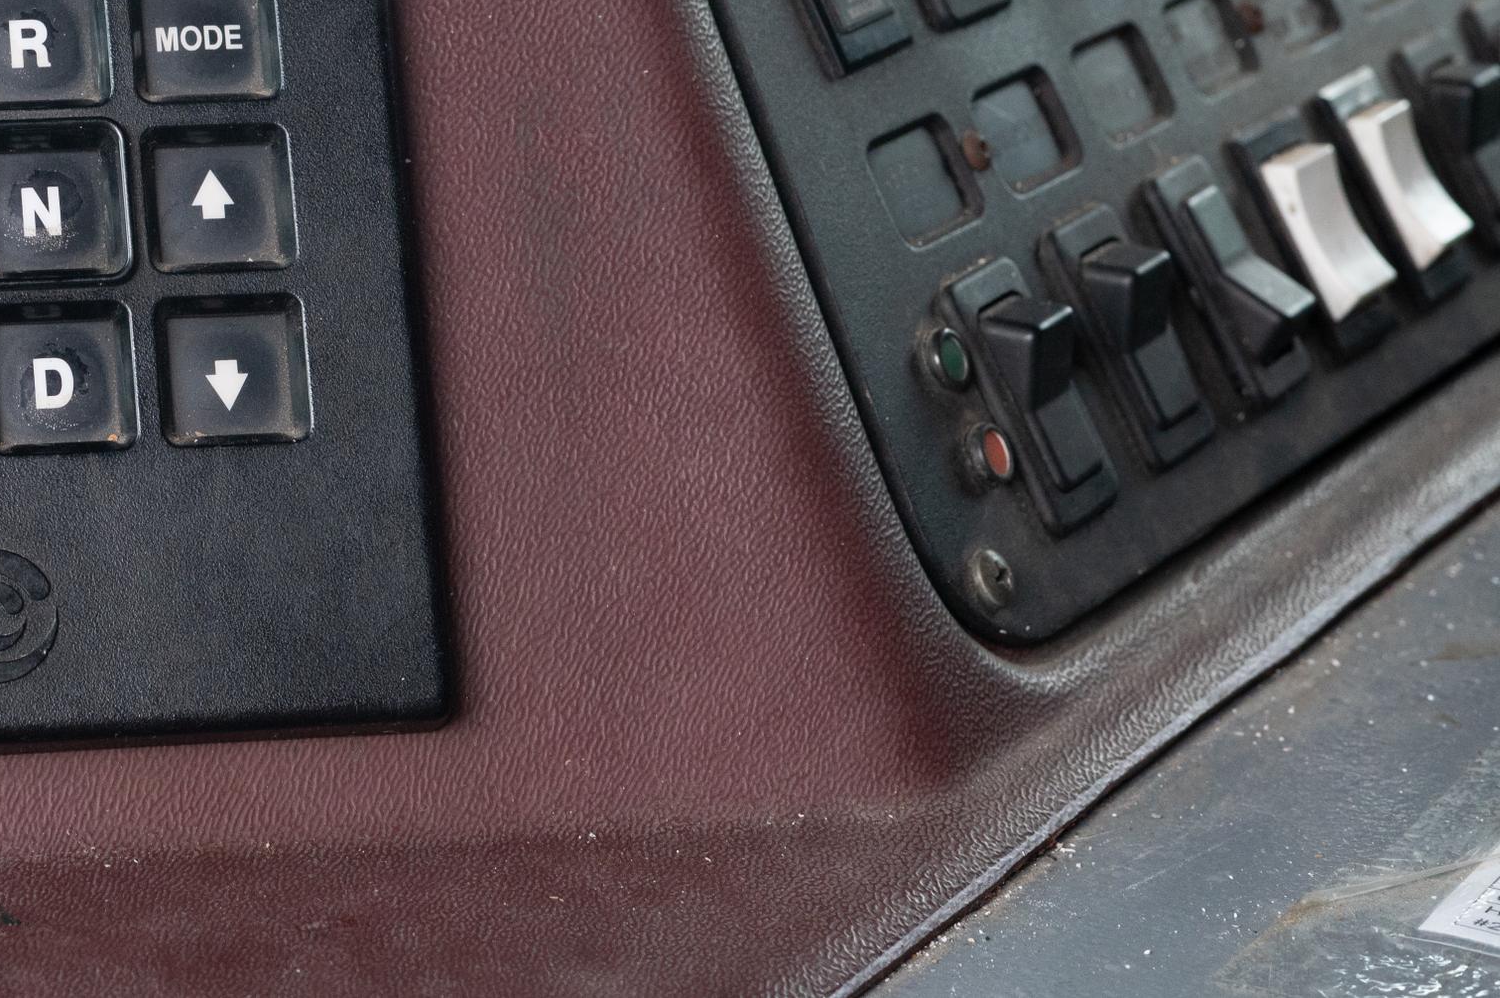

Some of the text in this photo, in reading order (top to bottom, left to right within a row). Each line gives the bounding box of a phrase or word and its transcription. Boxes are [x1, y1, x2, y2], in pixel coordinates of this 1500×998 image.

[8, 19, 51, 69] R
[155, 24, 243, 53] MODE
[21, 186, 62, 237] N
[32, 357, 74, 410] D
